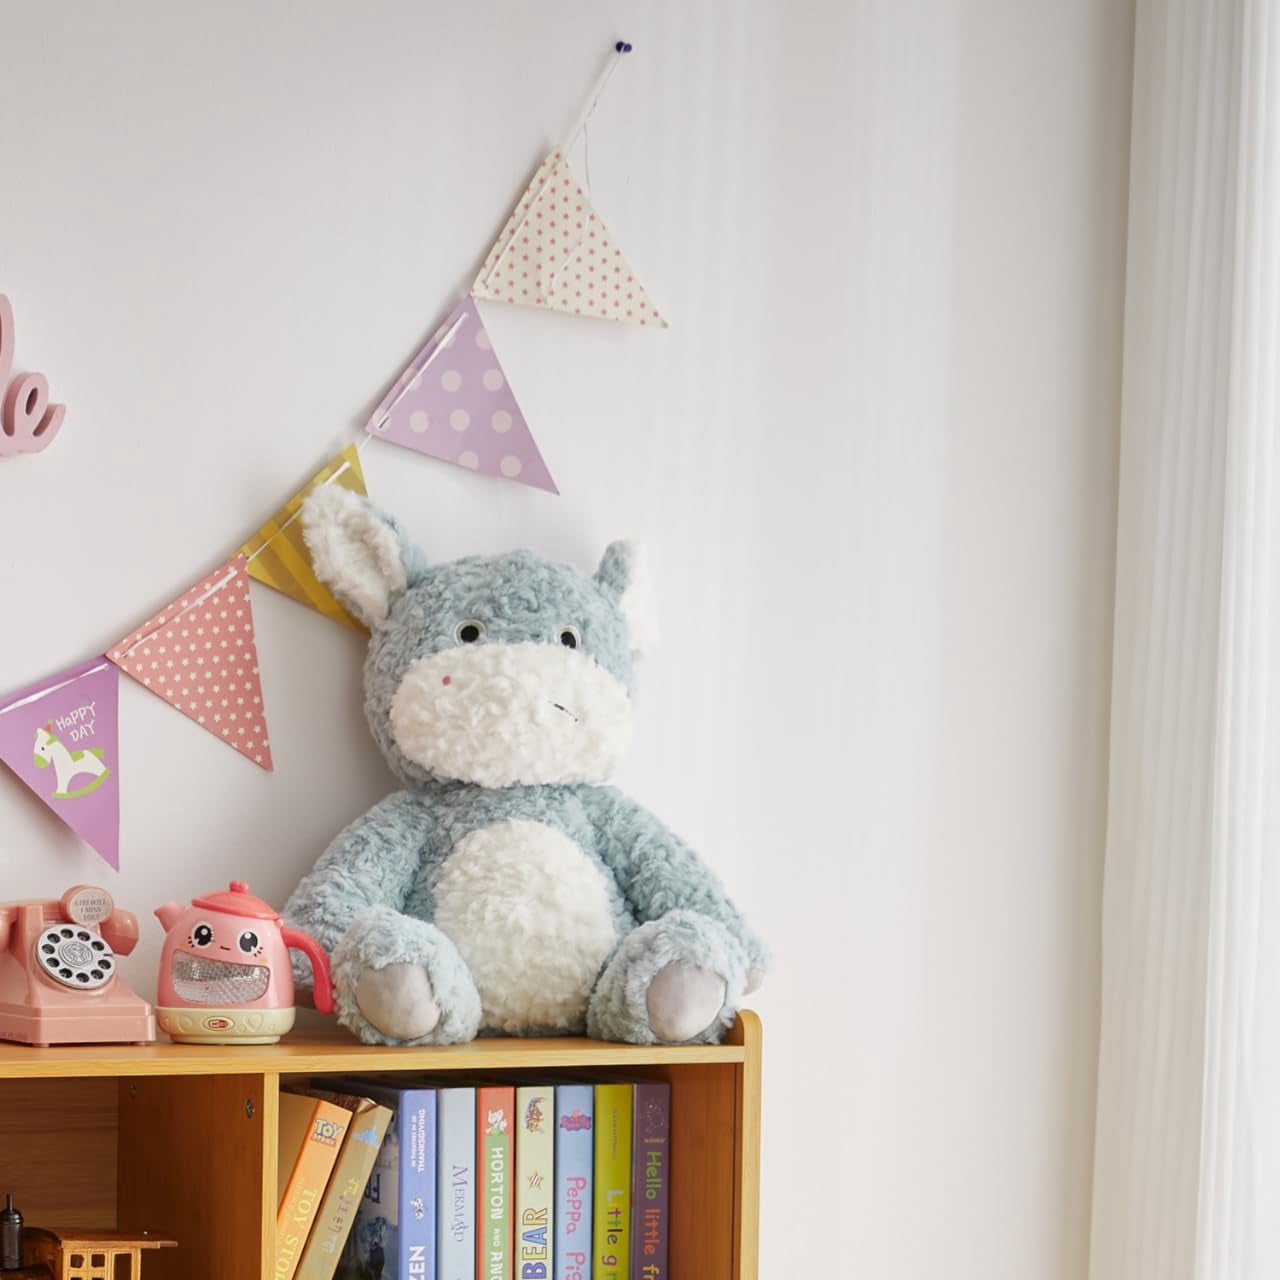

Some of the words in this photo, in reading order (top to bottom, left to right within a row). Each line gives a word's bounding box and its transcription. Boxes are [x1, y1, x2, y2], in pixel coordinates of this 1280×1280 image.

[70, 720, 95, 742] DAY
[315, 1118, 344, 1139] TOY
[418, 1108, 426, 1173] THANKSGIVING
[490, 1147, 504, 1220] HORTON
[645, 1151, 663, 1200] Hello
[293, 1188, 317, 1228] TOY
[644, 1208, 662, 1256] little
